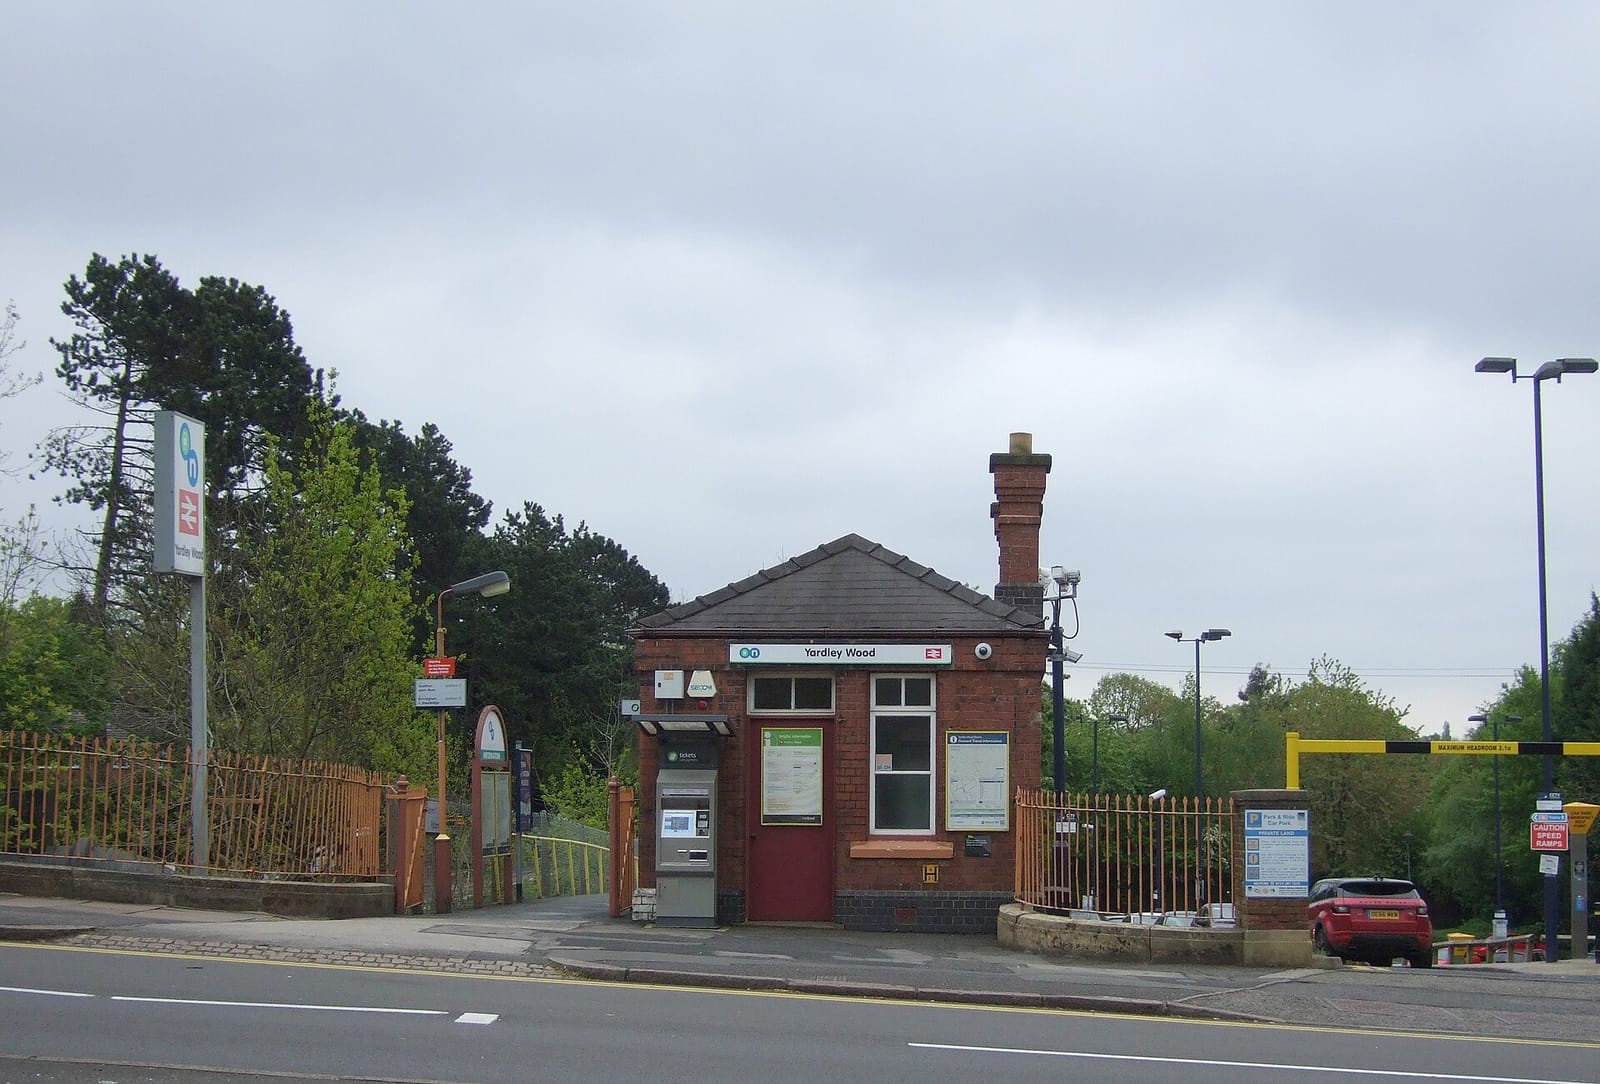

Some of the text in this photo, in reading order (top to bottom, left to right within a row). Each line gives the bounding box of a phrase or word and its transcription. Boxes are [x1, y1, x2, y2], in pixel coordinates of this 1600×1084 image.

[175, 545, 204, 560] Yardley Wood
[804, 648, 876, 660] Yardley Wood
